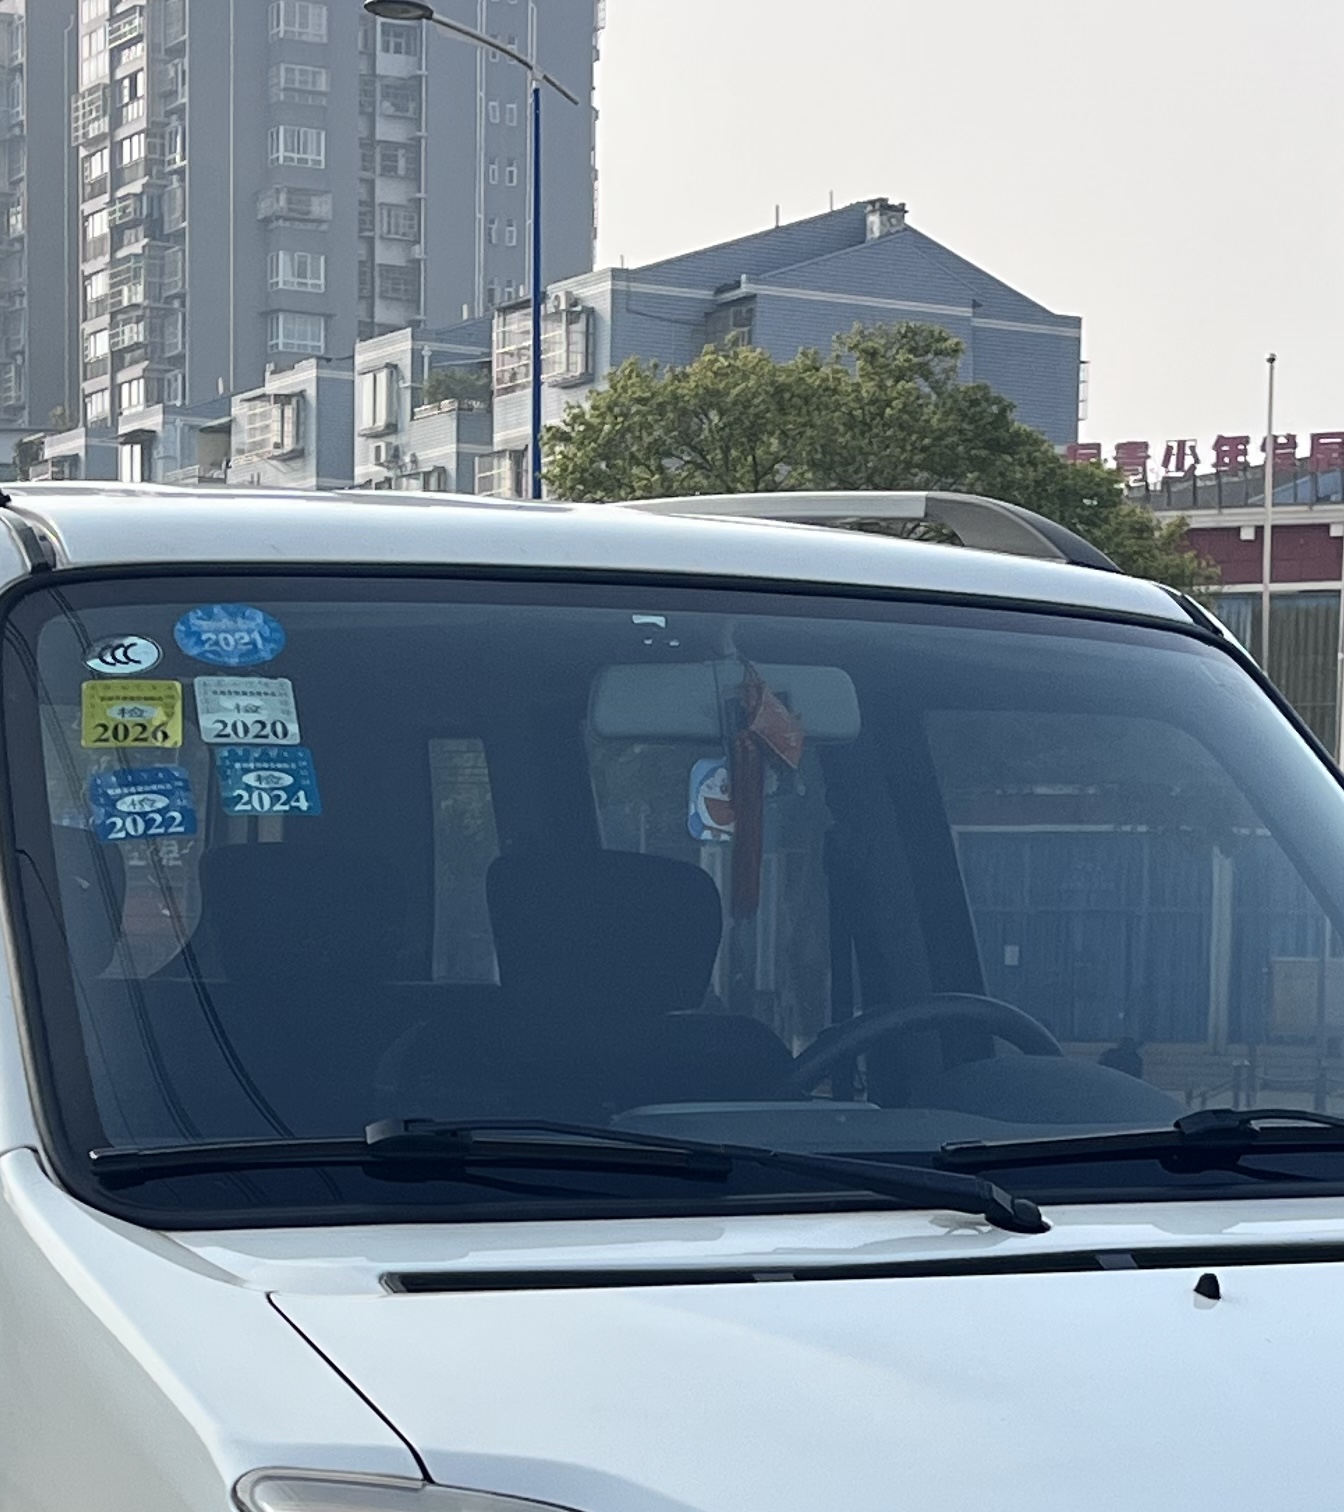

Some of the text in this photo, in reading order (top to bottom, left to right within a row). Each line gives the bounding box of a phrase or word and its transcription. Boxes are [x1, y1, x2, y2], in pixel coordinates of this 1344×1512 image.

[201, 630, 264, 651] 2021
[92, 722, 170, 744] 2026
[211, 719, 290, 740] 2020
[233, 790, 310, 813] 2024
[105, 811, 186, 840] 2022
